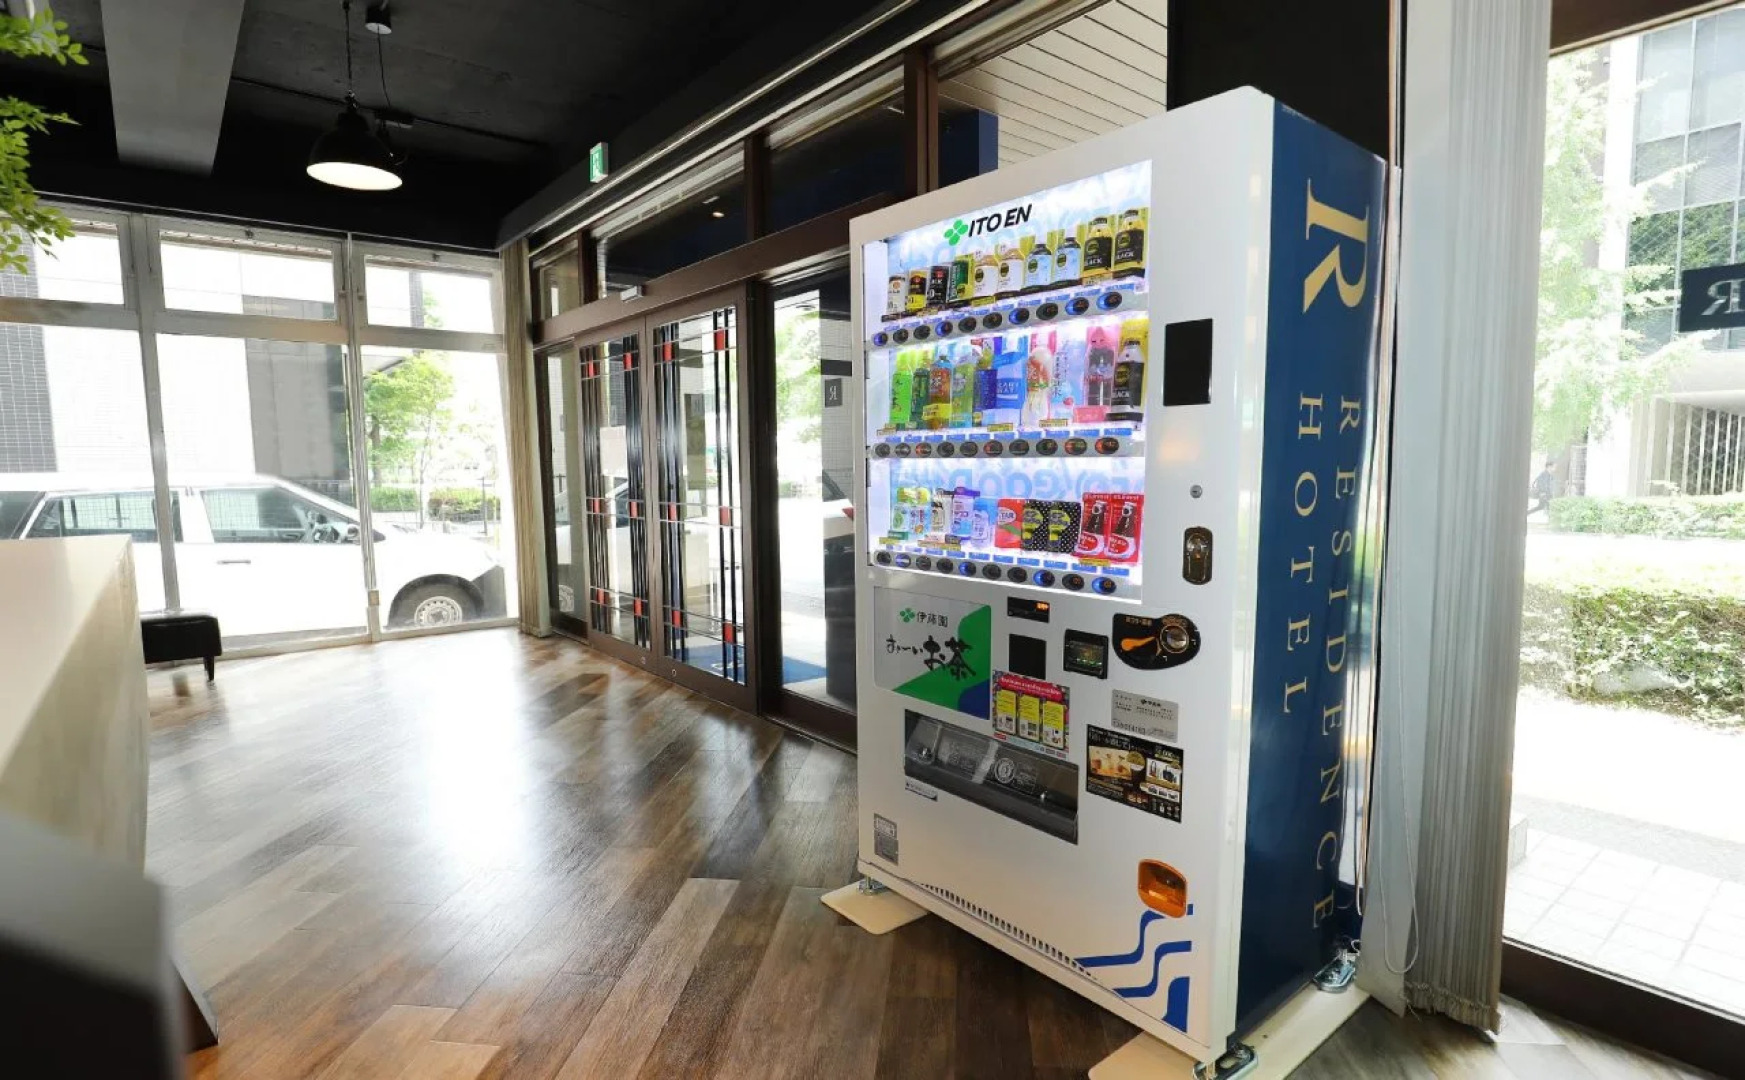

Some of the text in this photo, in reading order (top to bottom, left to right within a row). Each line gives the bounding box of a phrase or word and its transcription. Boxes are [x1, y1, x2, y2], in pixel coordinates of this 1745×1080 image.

[968, 204, 1032, 237] ITO EN
[1302, 177, 1370, 313] R
[917, 611, 948, 628] 伊藤園
[1283, 393, 1323, 713] HOTEL
[1312, 395, 1362, 929] RESIDENCE
